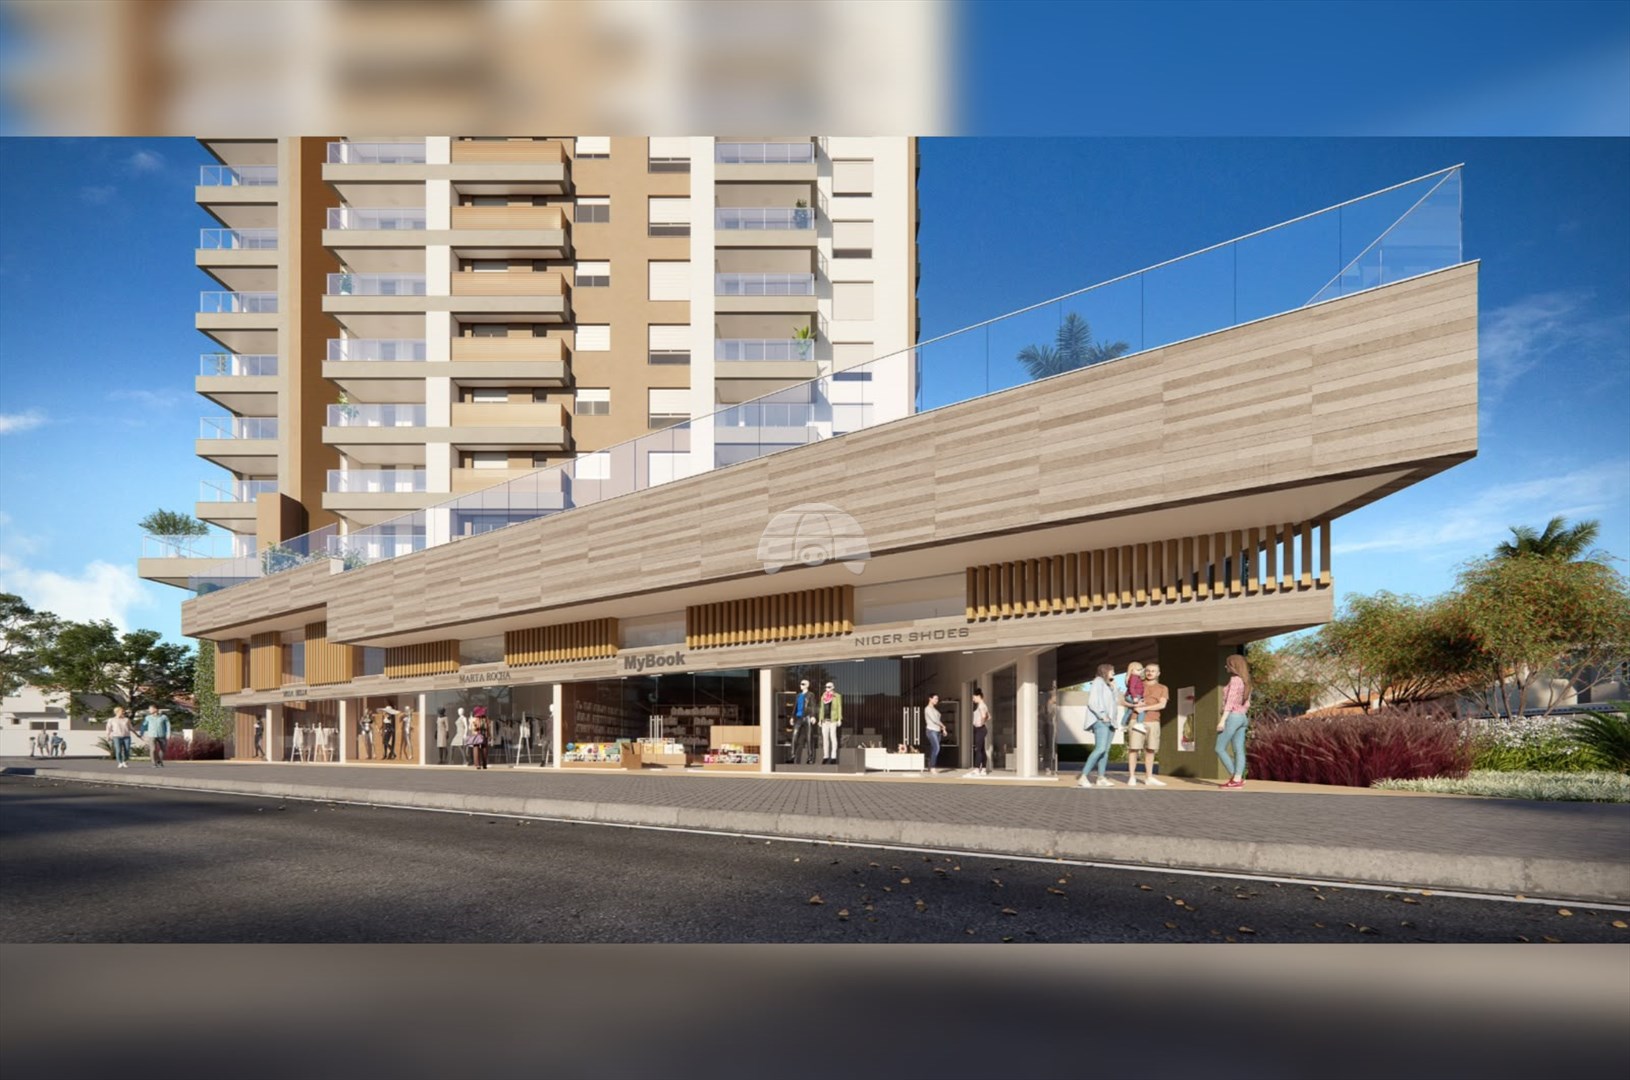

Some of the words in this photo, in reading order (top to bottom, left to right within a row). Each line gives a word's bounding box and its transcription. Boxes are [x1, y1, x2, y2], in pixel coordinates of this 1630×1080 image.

[855, 633, 903, 647] NICER
[908, 627, 970, 642] SHOES
[624, 651, 686, 672] MyBook
